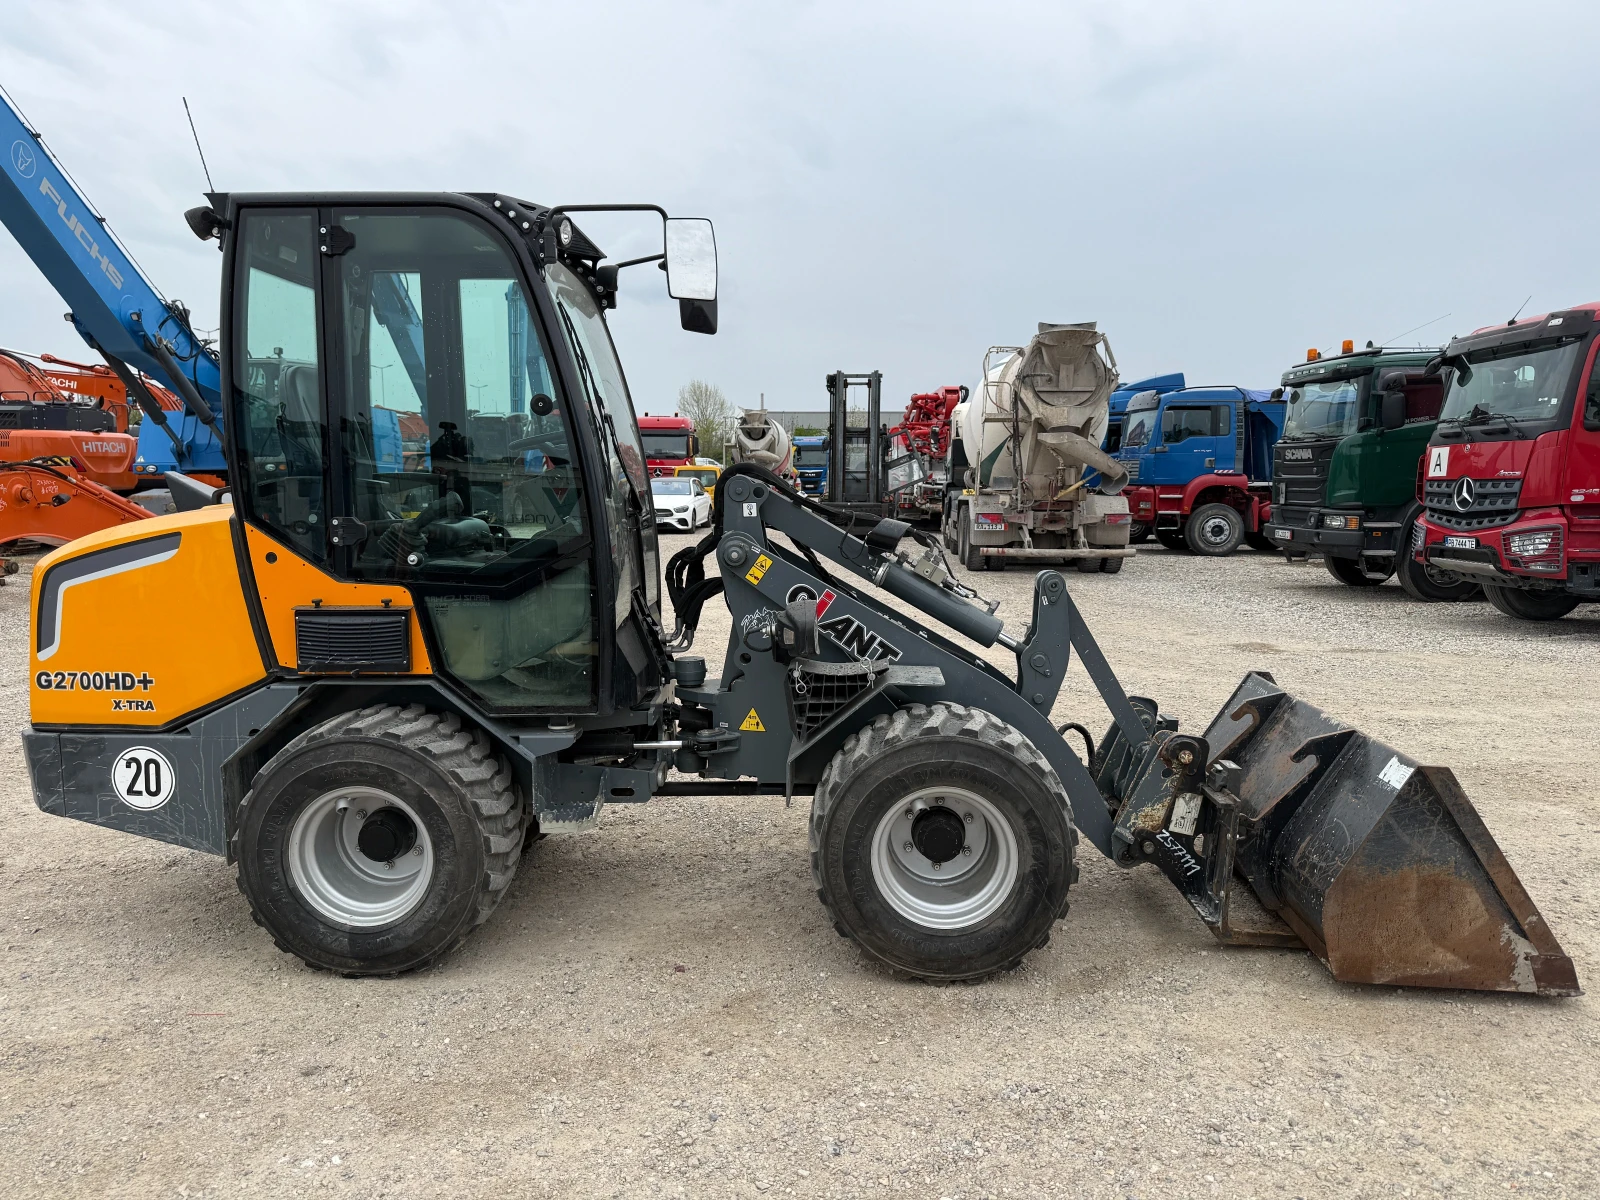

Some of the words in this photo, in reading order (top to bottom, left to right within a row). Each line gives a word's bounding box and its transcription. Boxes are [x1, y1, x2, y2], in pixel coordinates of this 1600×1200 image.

[39, 176, 124, 291] FUCHS
[82, 440, 127, 454] HITACHI
[1284, 448, 1313, 460] SCANIA
[1432, 451, 1443, 473] A
[36, 671, 155, 691] G2700HD+
[112, 699, 156, 712] X-TRA
[125, 756, 163, 798] 20
